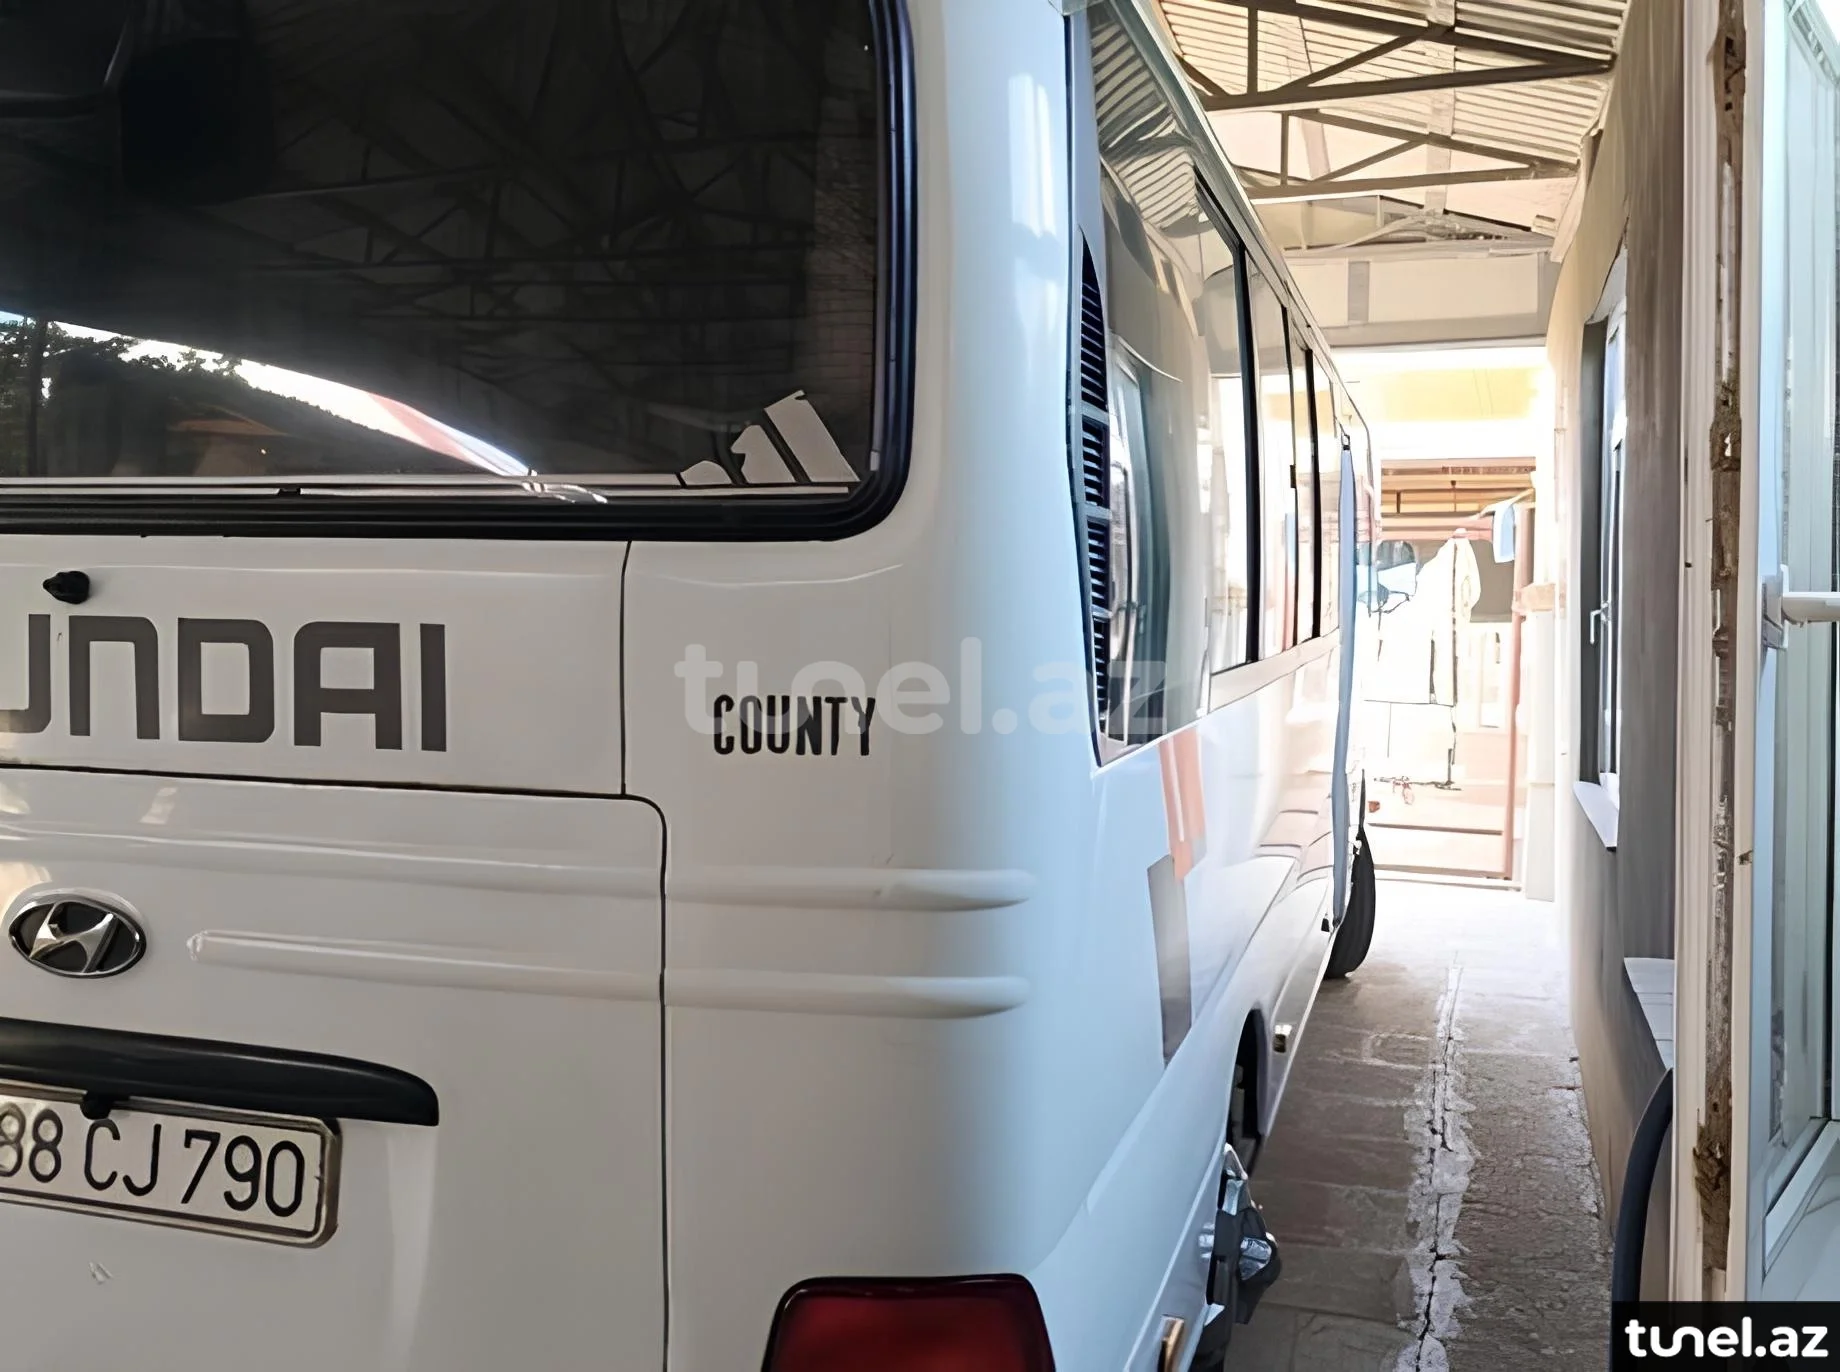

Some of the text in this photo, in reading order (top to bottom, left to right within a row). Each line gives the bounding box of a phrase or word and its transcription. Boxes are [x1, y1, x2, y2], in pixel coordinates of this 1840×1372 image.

[713, 694, 876, 756] COUNTY
[84, 1118, 162, 1197] CJ
[180, 1128, 305, 1217] 790
